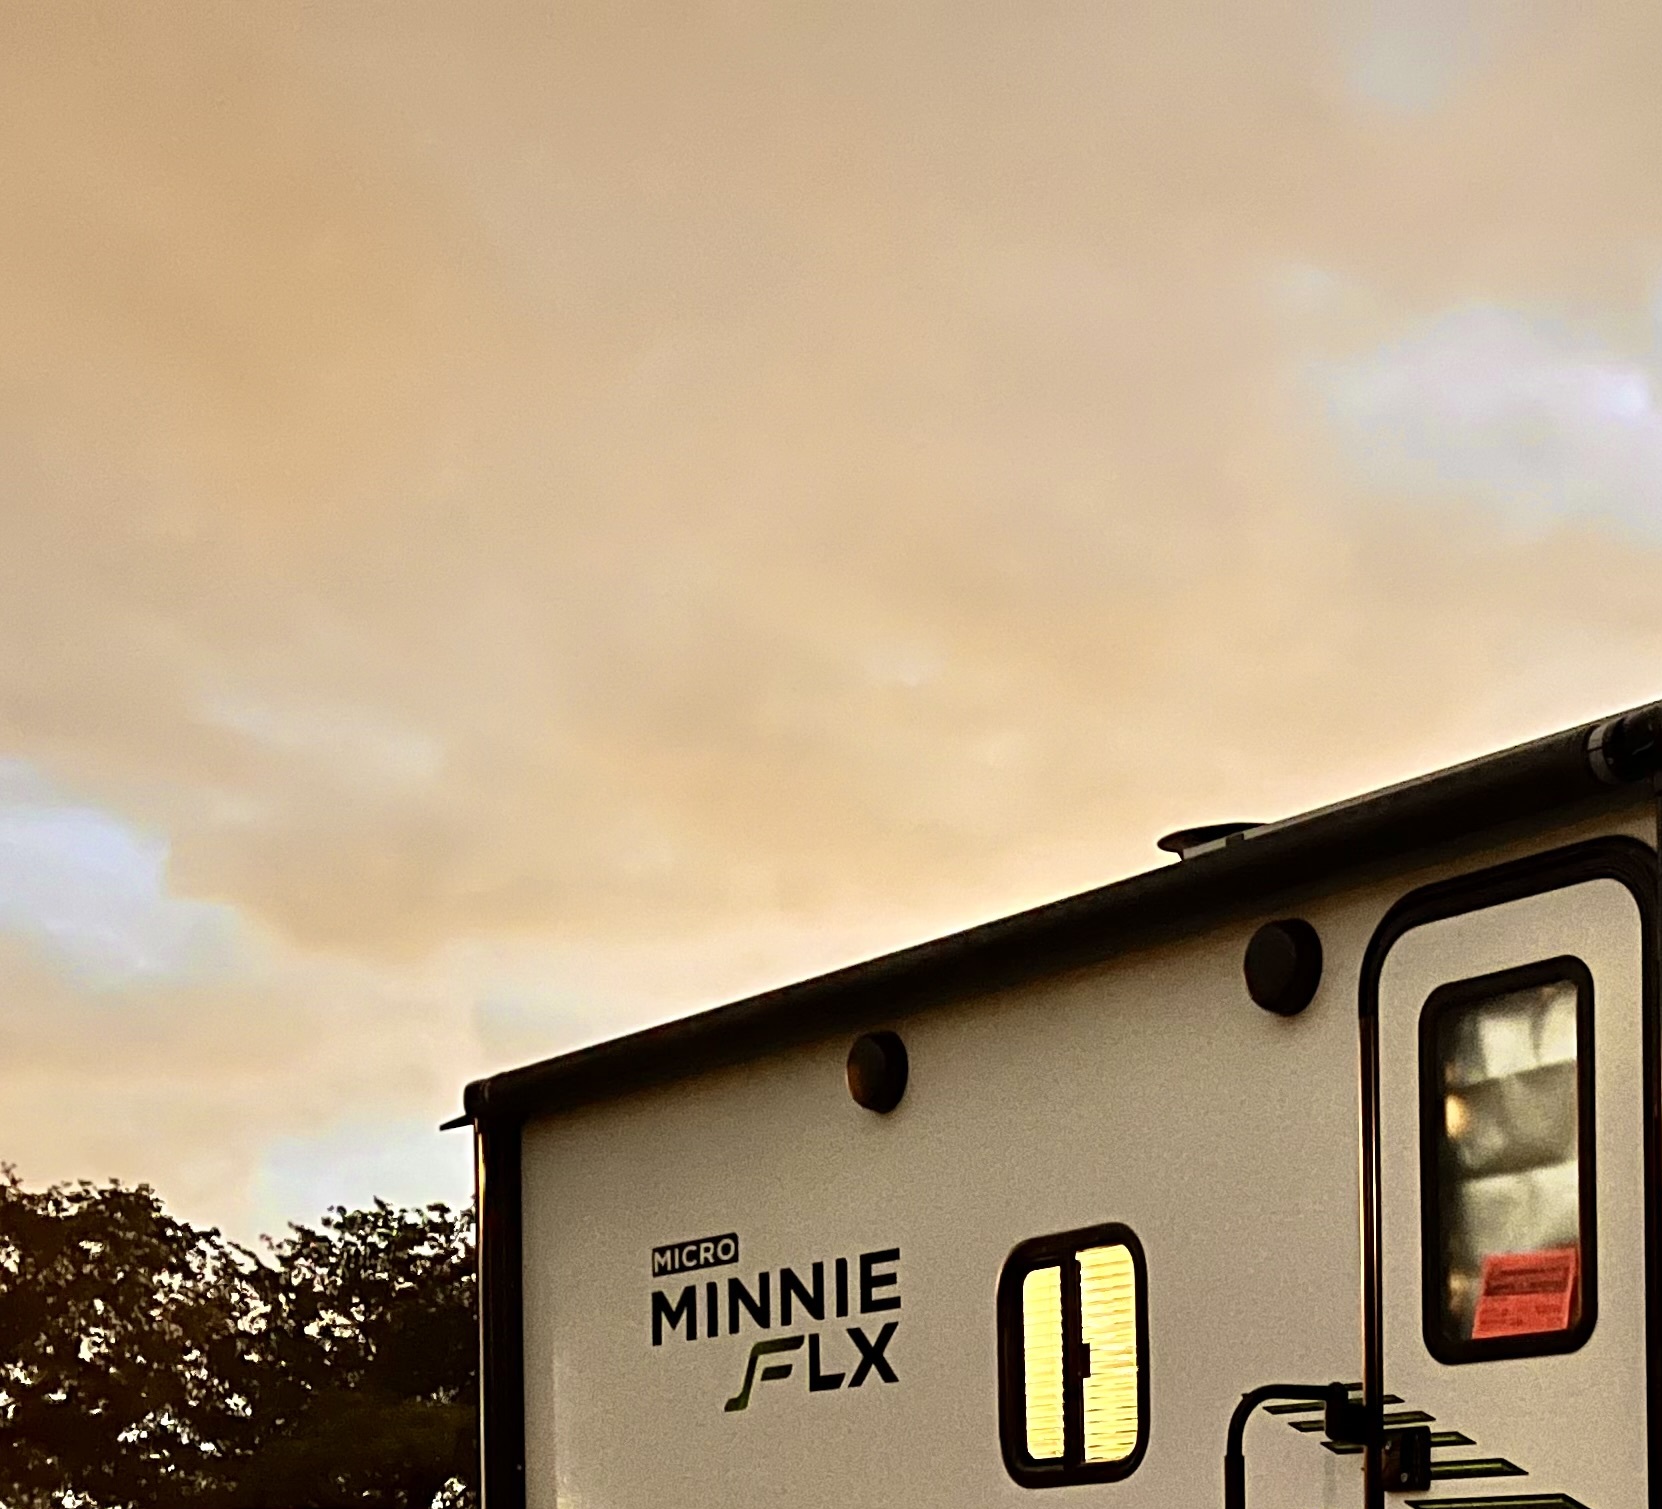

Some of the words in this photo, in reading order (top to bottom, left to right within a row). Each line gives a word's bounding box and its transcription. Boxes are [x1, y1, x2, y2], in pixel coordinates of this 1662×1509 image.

[651, 1247, 901, 1346] MINNIE
[653, 1238, 736, 1273] MICRO
[723, 1321, 900, 1413] FLX
